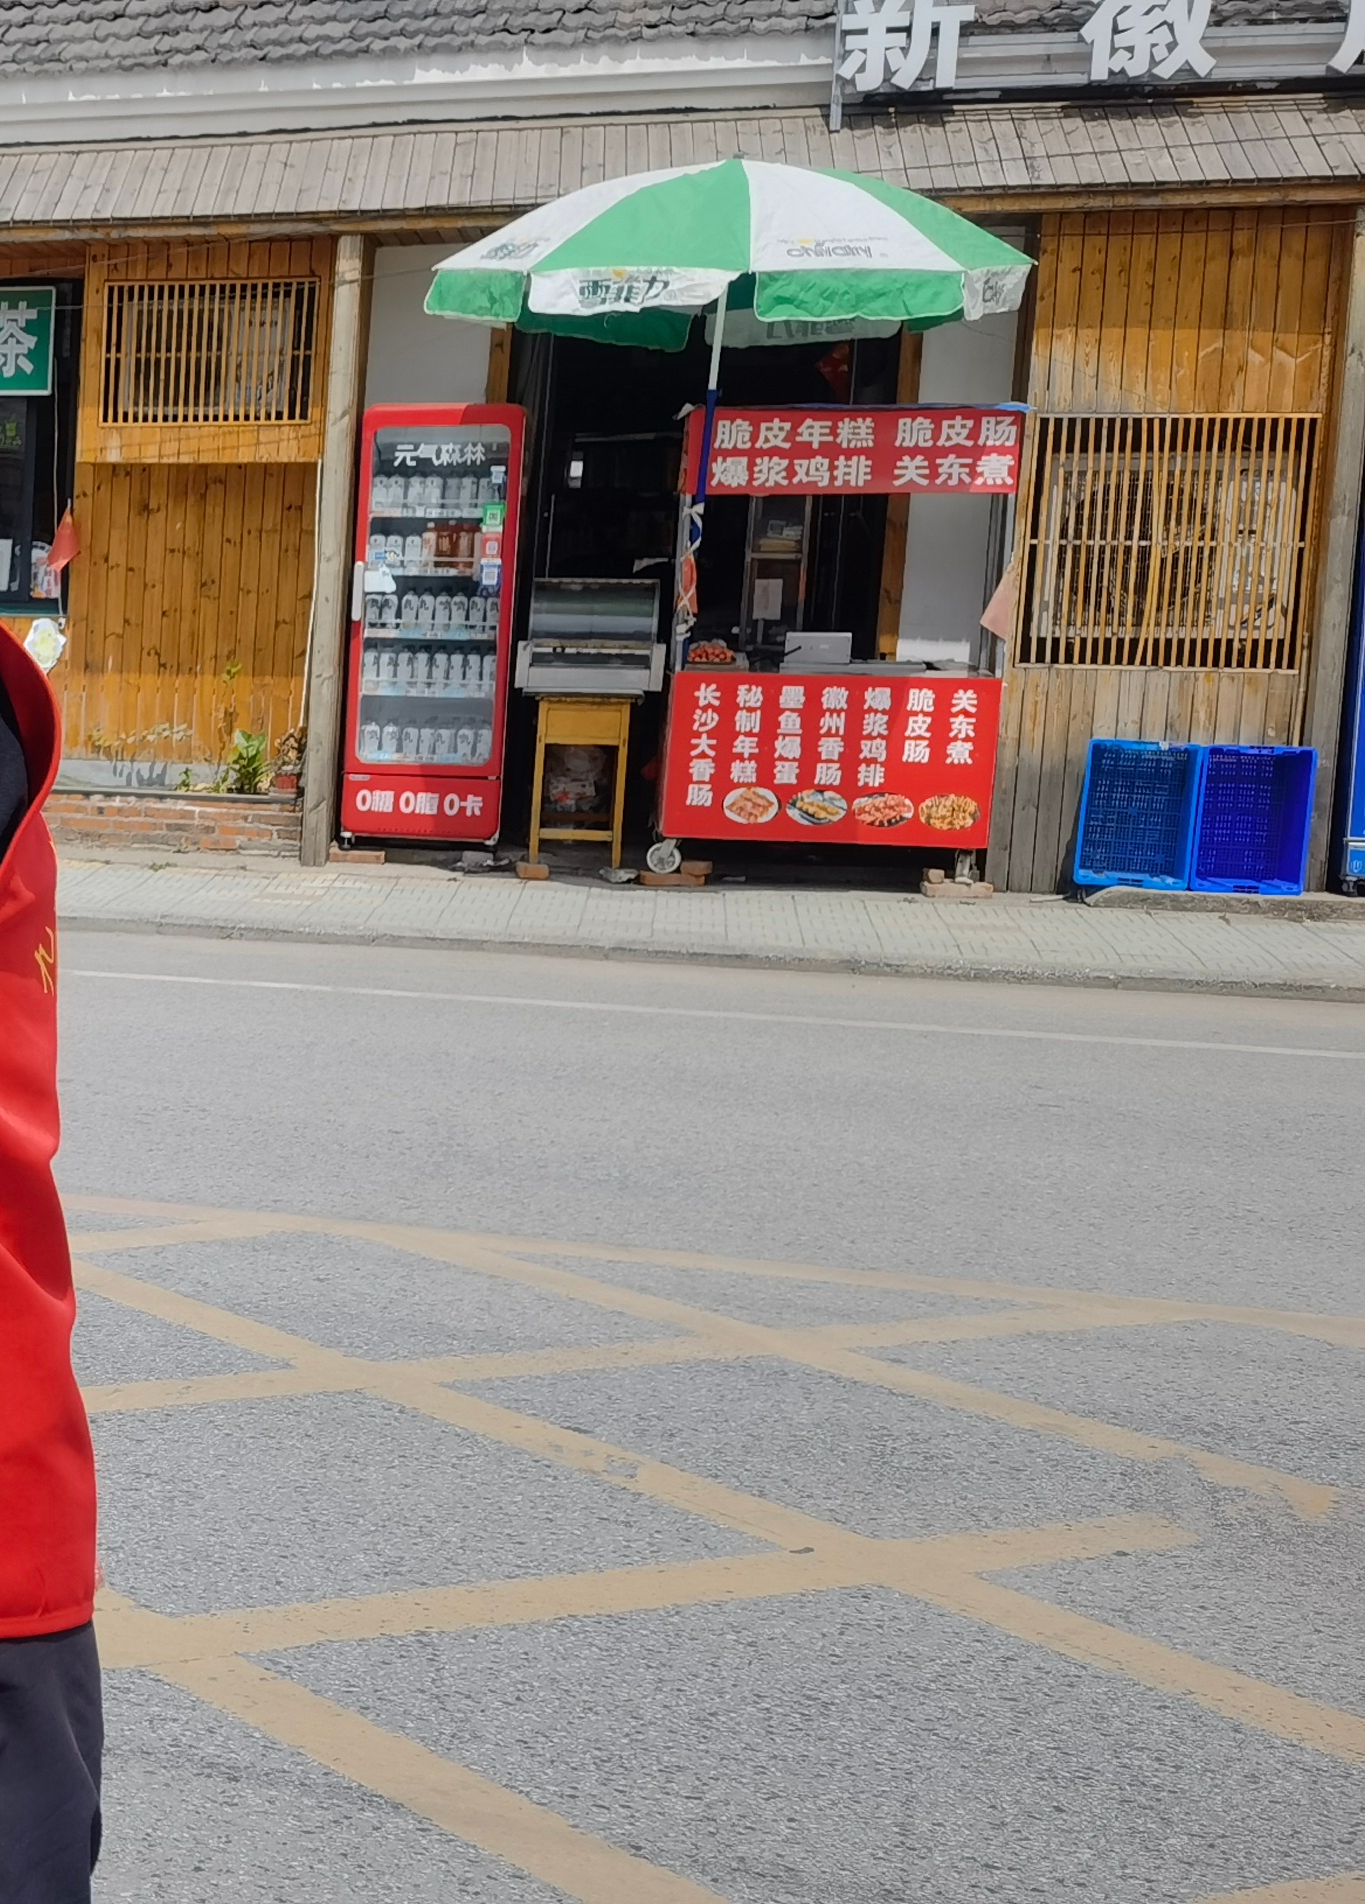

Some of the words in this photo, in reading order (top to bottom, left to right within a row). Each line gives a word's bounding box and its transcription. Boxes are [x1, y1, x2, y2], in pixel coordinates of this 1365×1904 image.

[837, 0, 1365, 91] 新徽
[711, 456, 872, 487] 爆浆鸡排
[893, 453, 1015, 486] 关东煮
[714, 418, 875, 449] 脆皮年糕
[894, 416, 1017, 447] 脆皮肠
[686, 683, 721, 807] 长沙大香肠
[730, 684, 764, 783] 秘制年糕
[814, 686, 848, 787] 徽州香肠
[858, 687, 892, 787] 爆浆鸡排
[902, 688, 936, 764] 脆皮肠
[946, 689, 979, 765] 关东煮
[443, 793, 483, 817] 0卡
